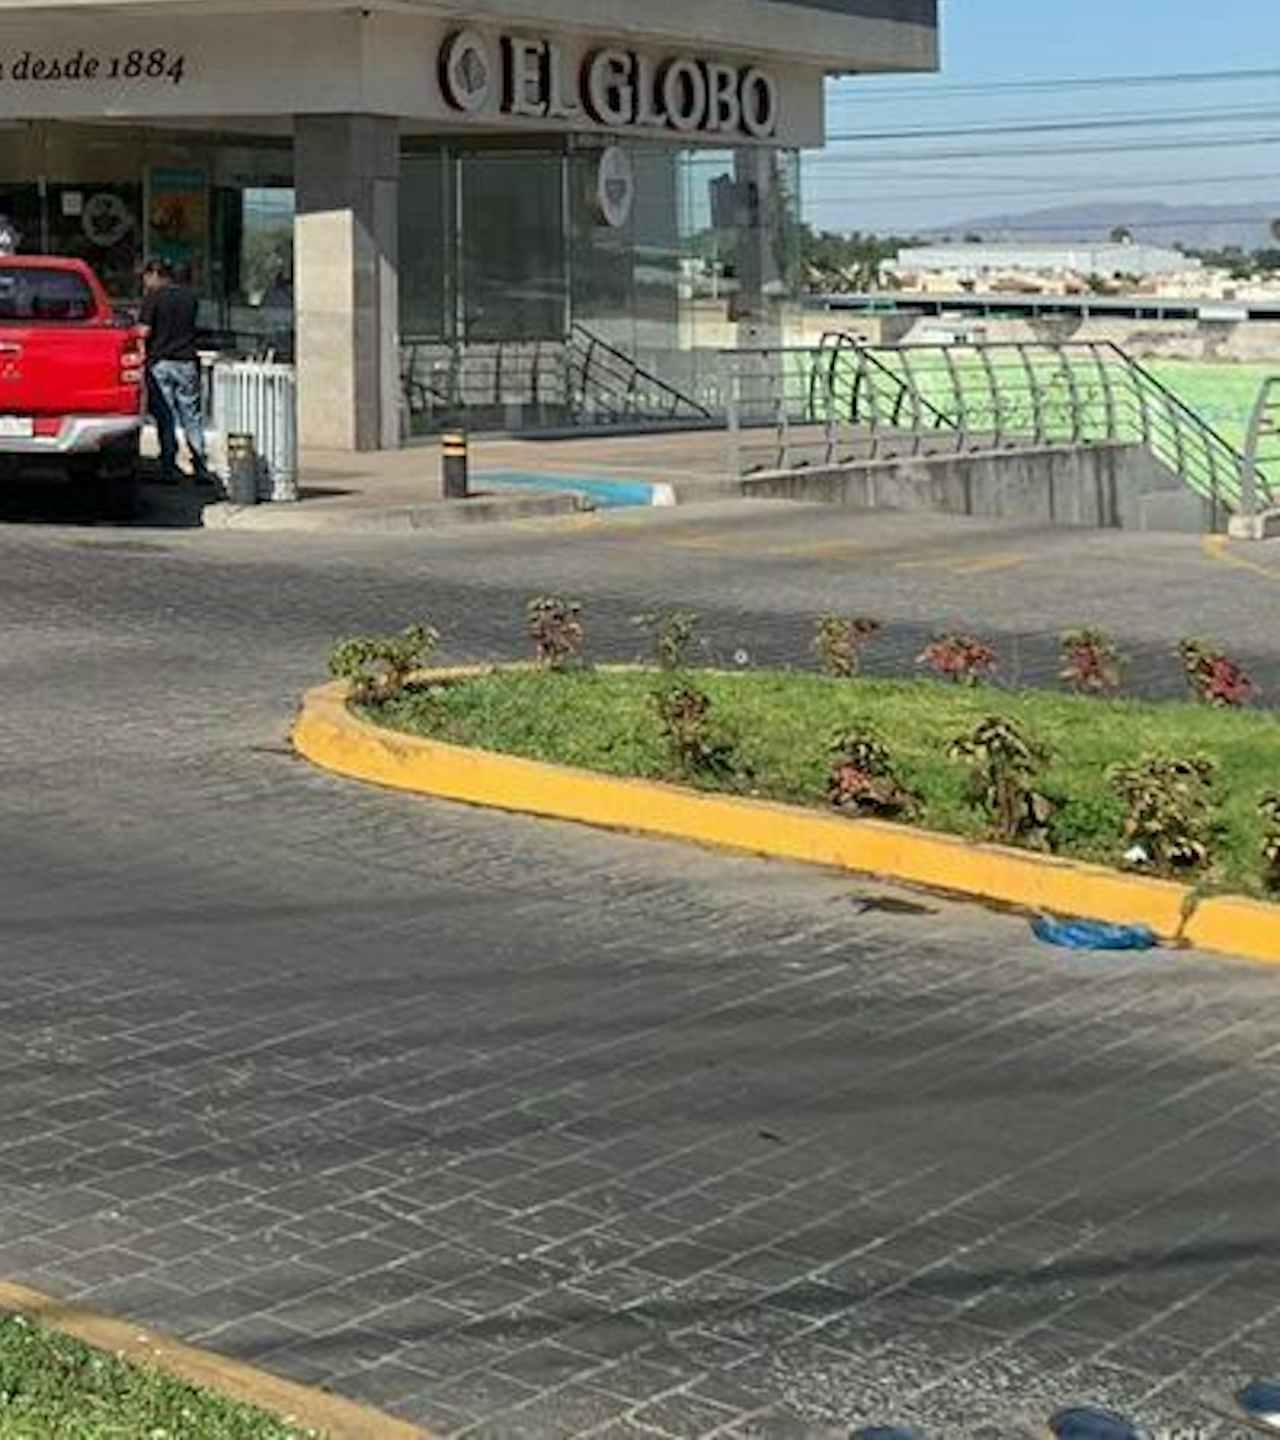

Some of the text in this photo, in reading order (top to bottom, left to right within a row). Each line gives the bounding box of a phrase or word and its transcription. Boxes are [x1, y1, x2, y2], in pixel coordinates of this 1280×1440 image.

[12, 50, 100, 81] desde
[107, 48, 185, 84] 1884
[501, 35, 780, 138] EL GLOBO
